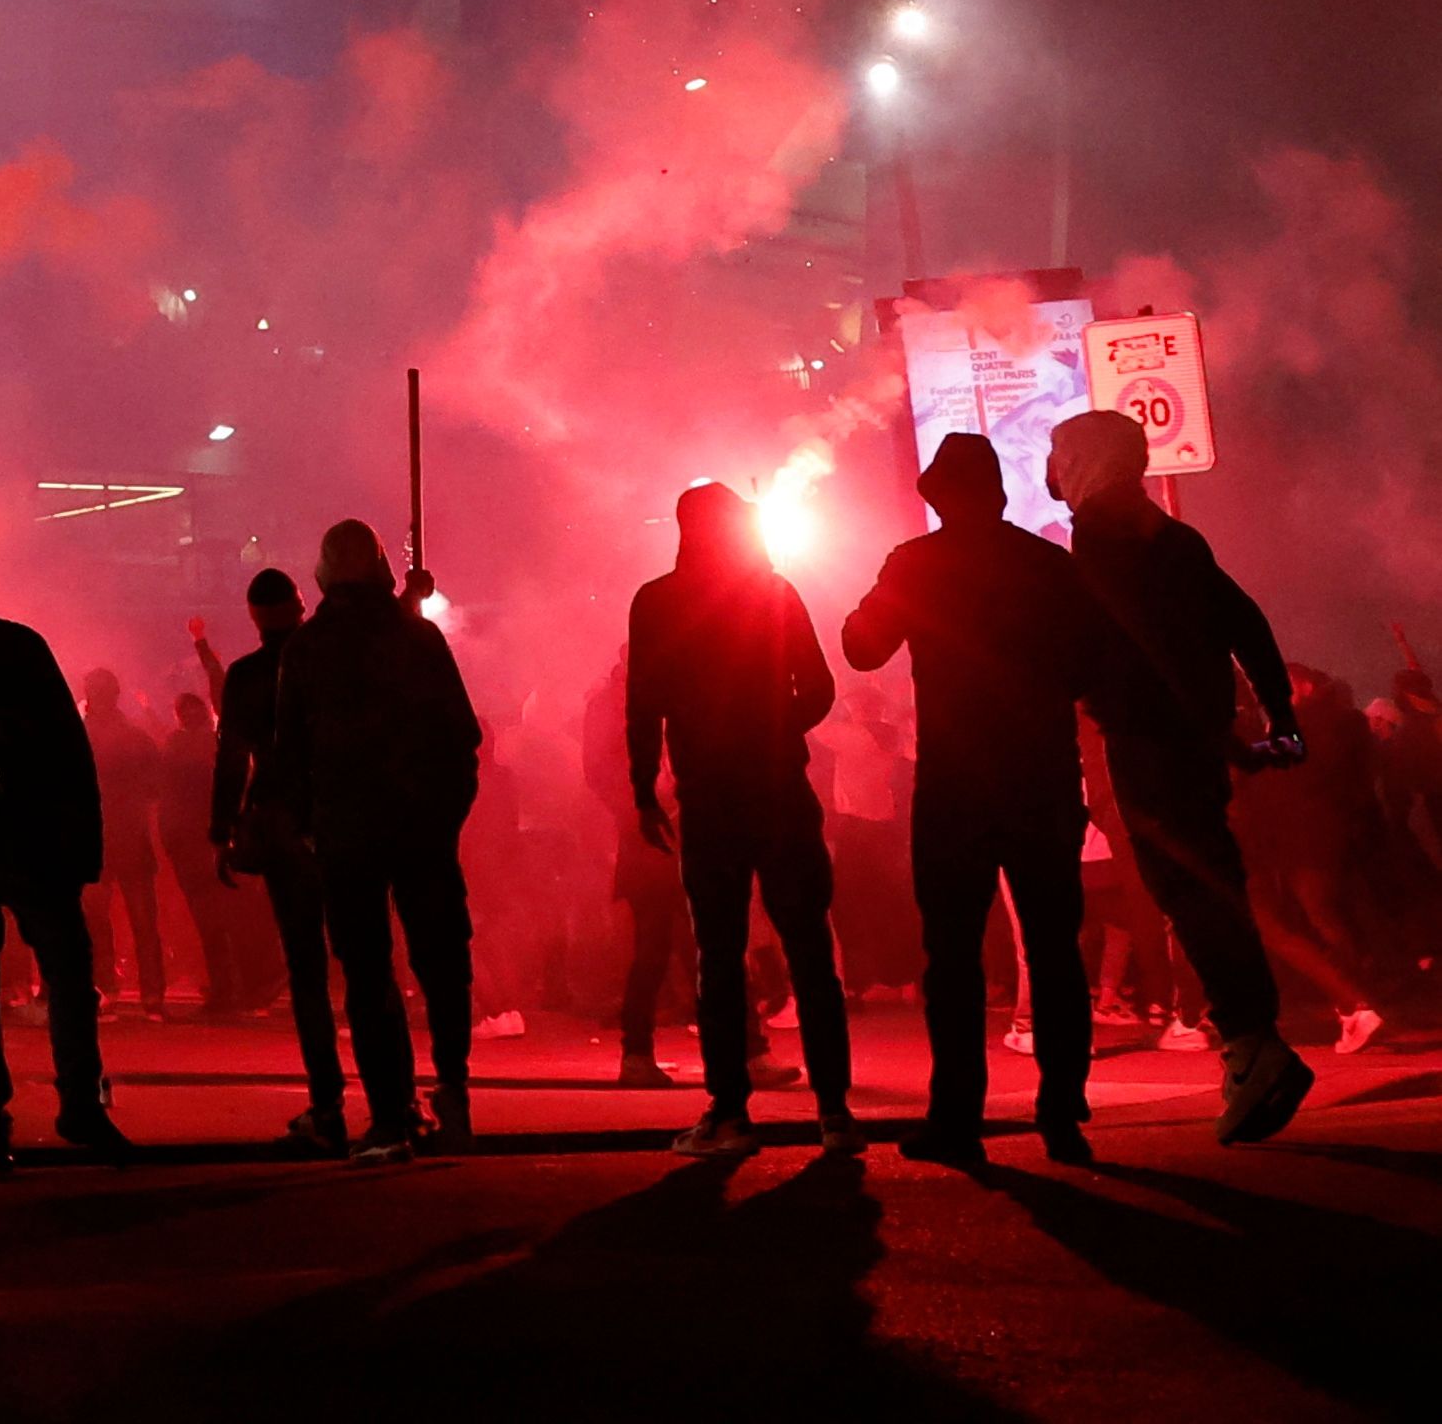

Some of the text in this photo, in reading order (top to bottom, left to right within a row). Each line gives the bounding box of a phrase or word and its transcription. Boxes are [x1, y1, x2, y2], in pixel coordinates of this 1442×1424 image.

[970, 351, 998, 362] CENT
[972, 360, 1014, 372] QUATRE
[1129, 397, 1171, 428] 30
